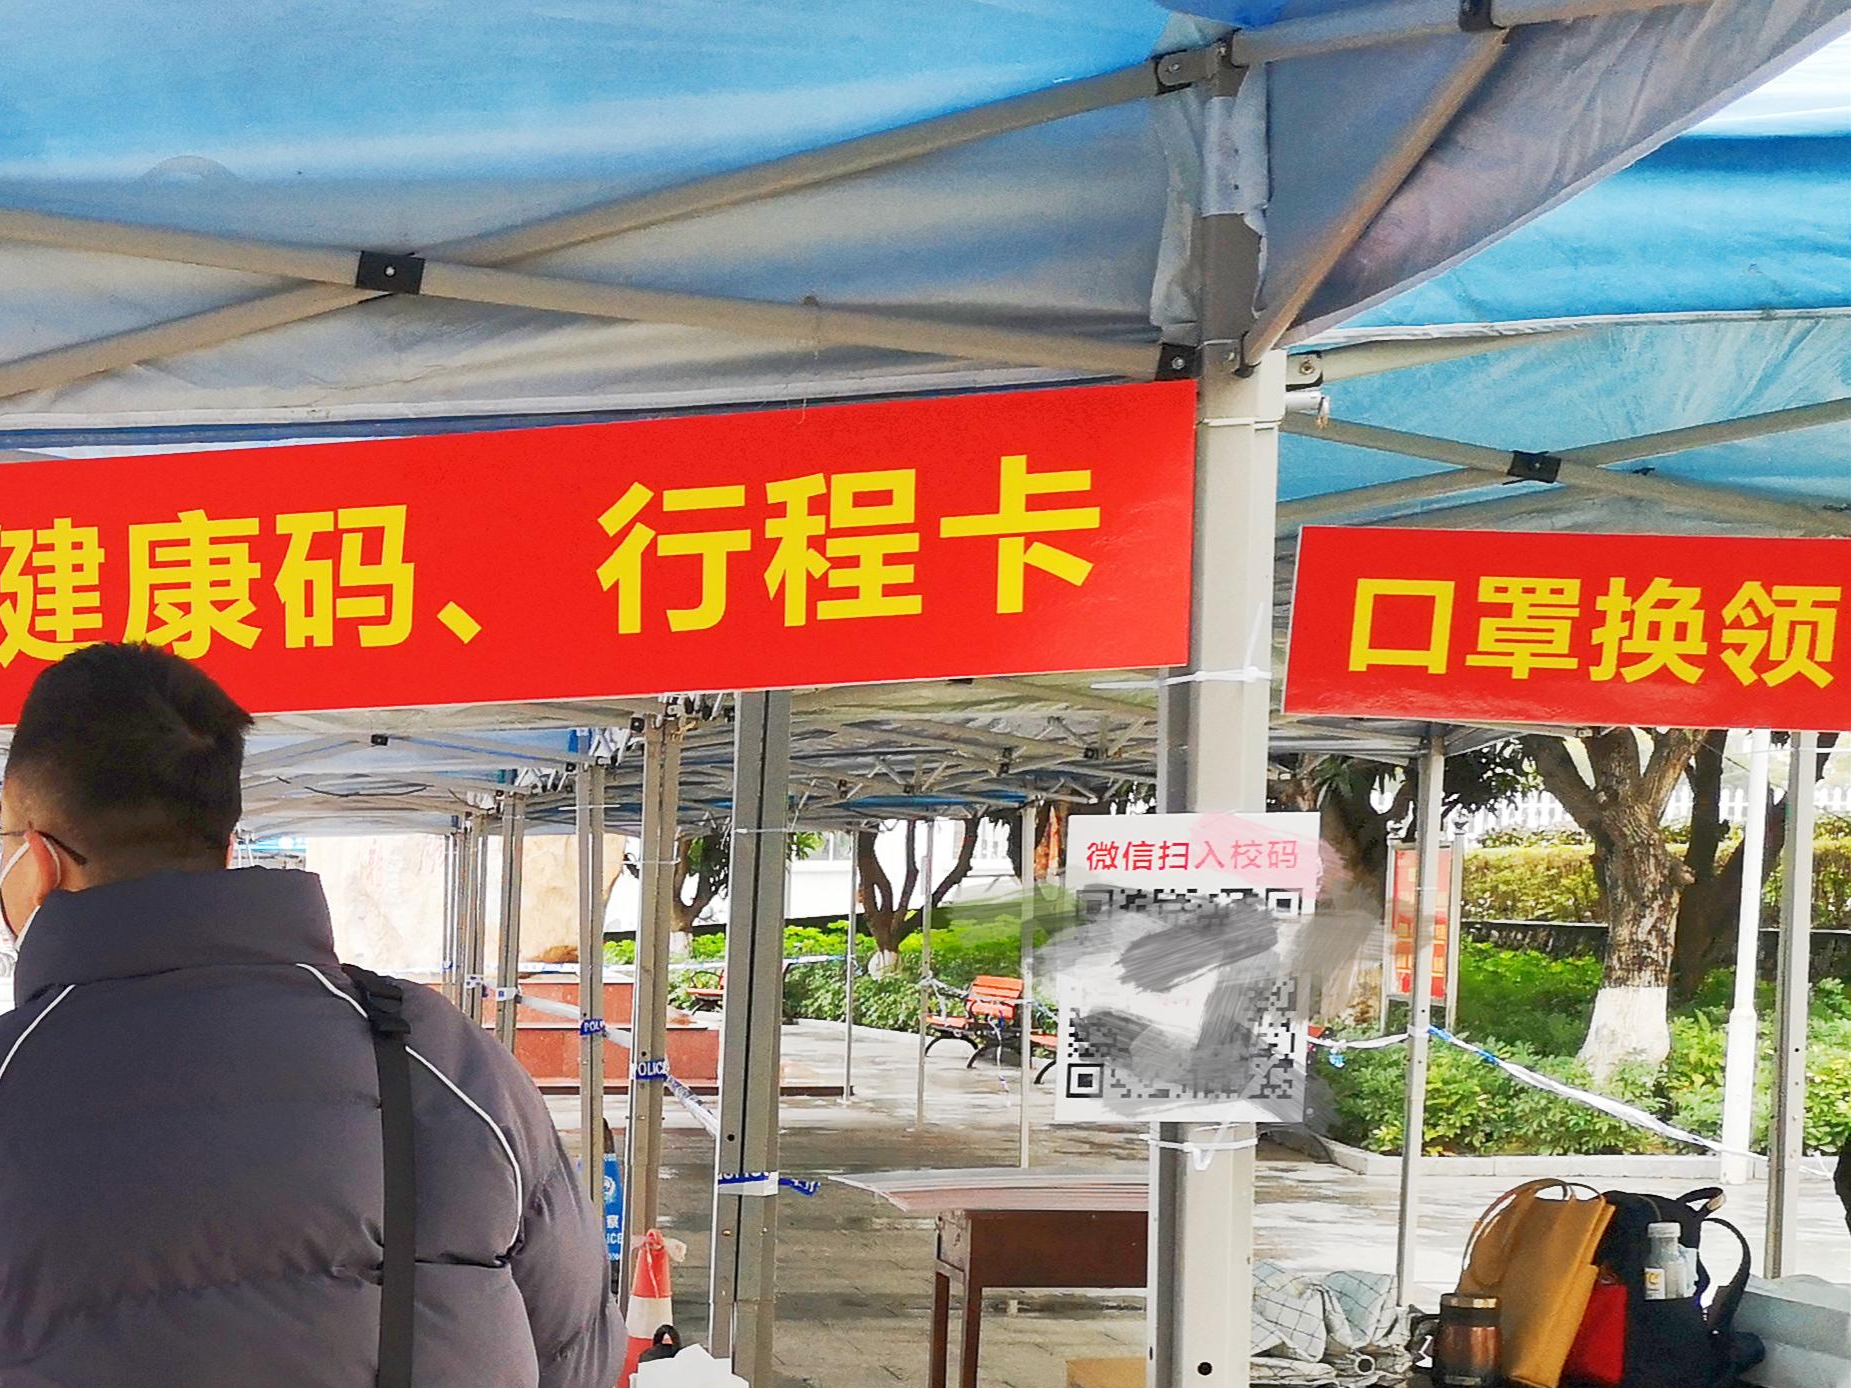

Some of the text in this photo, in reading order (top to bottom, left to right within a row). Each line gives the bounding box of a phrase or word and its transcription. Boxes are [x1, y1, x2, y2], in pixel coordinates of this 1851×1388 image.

[598, 456, 1100, 634] 行程卡
[1349, 577, 1841, 688] 口罩换领
[1086, 840, 1298, 871] 微信扫入校码
